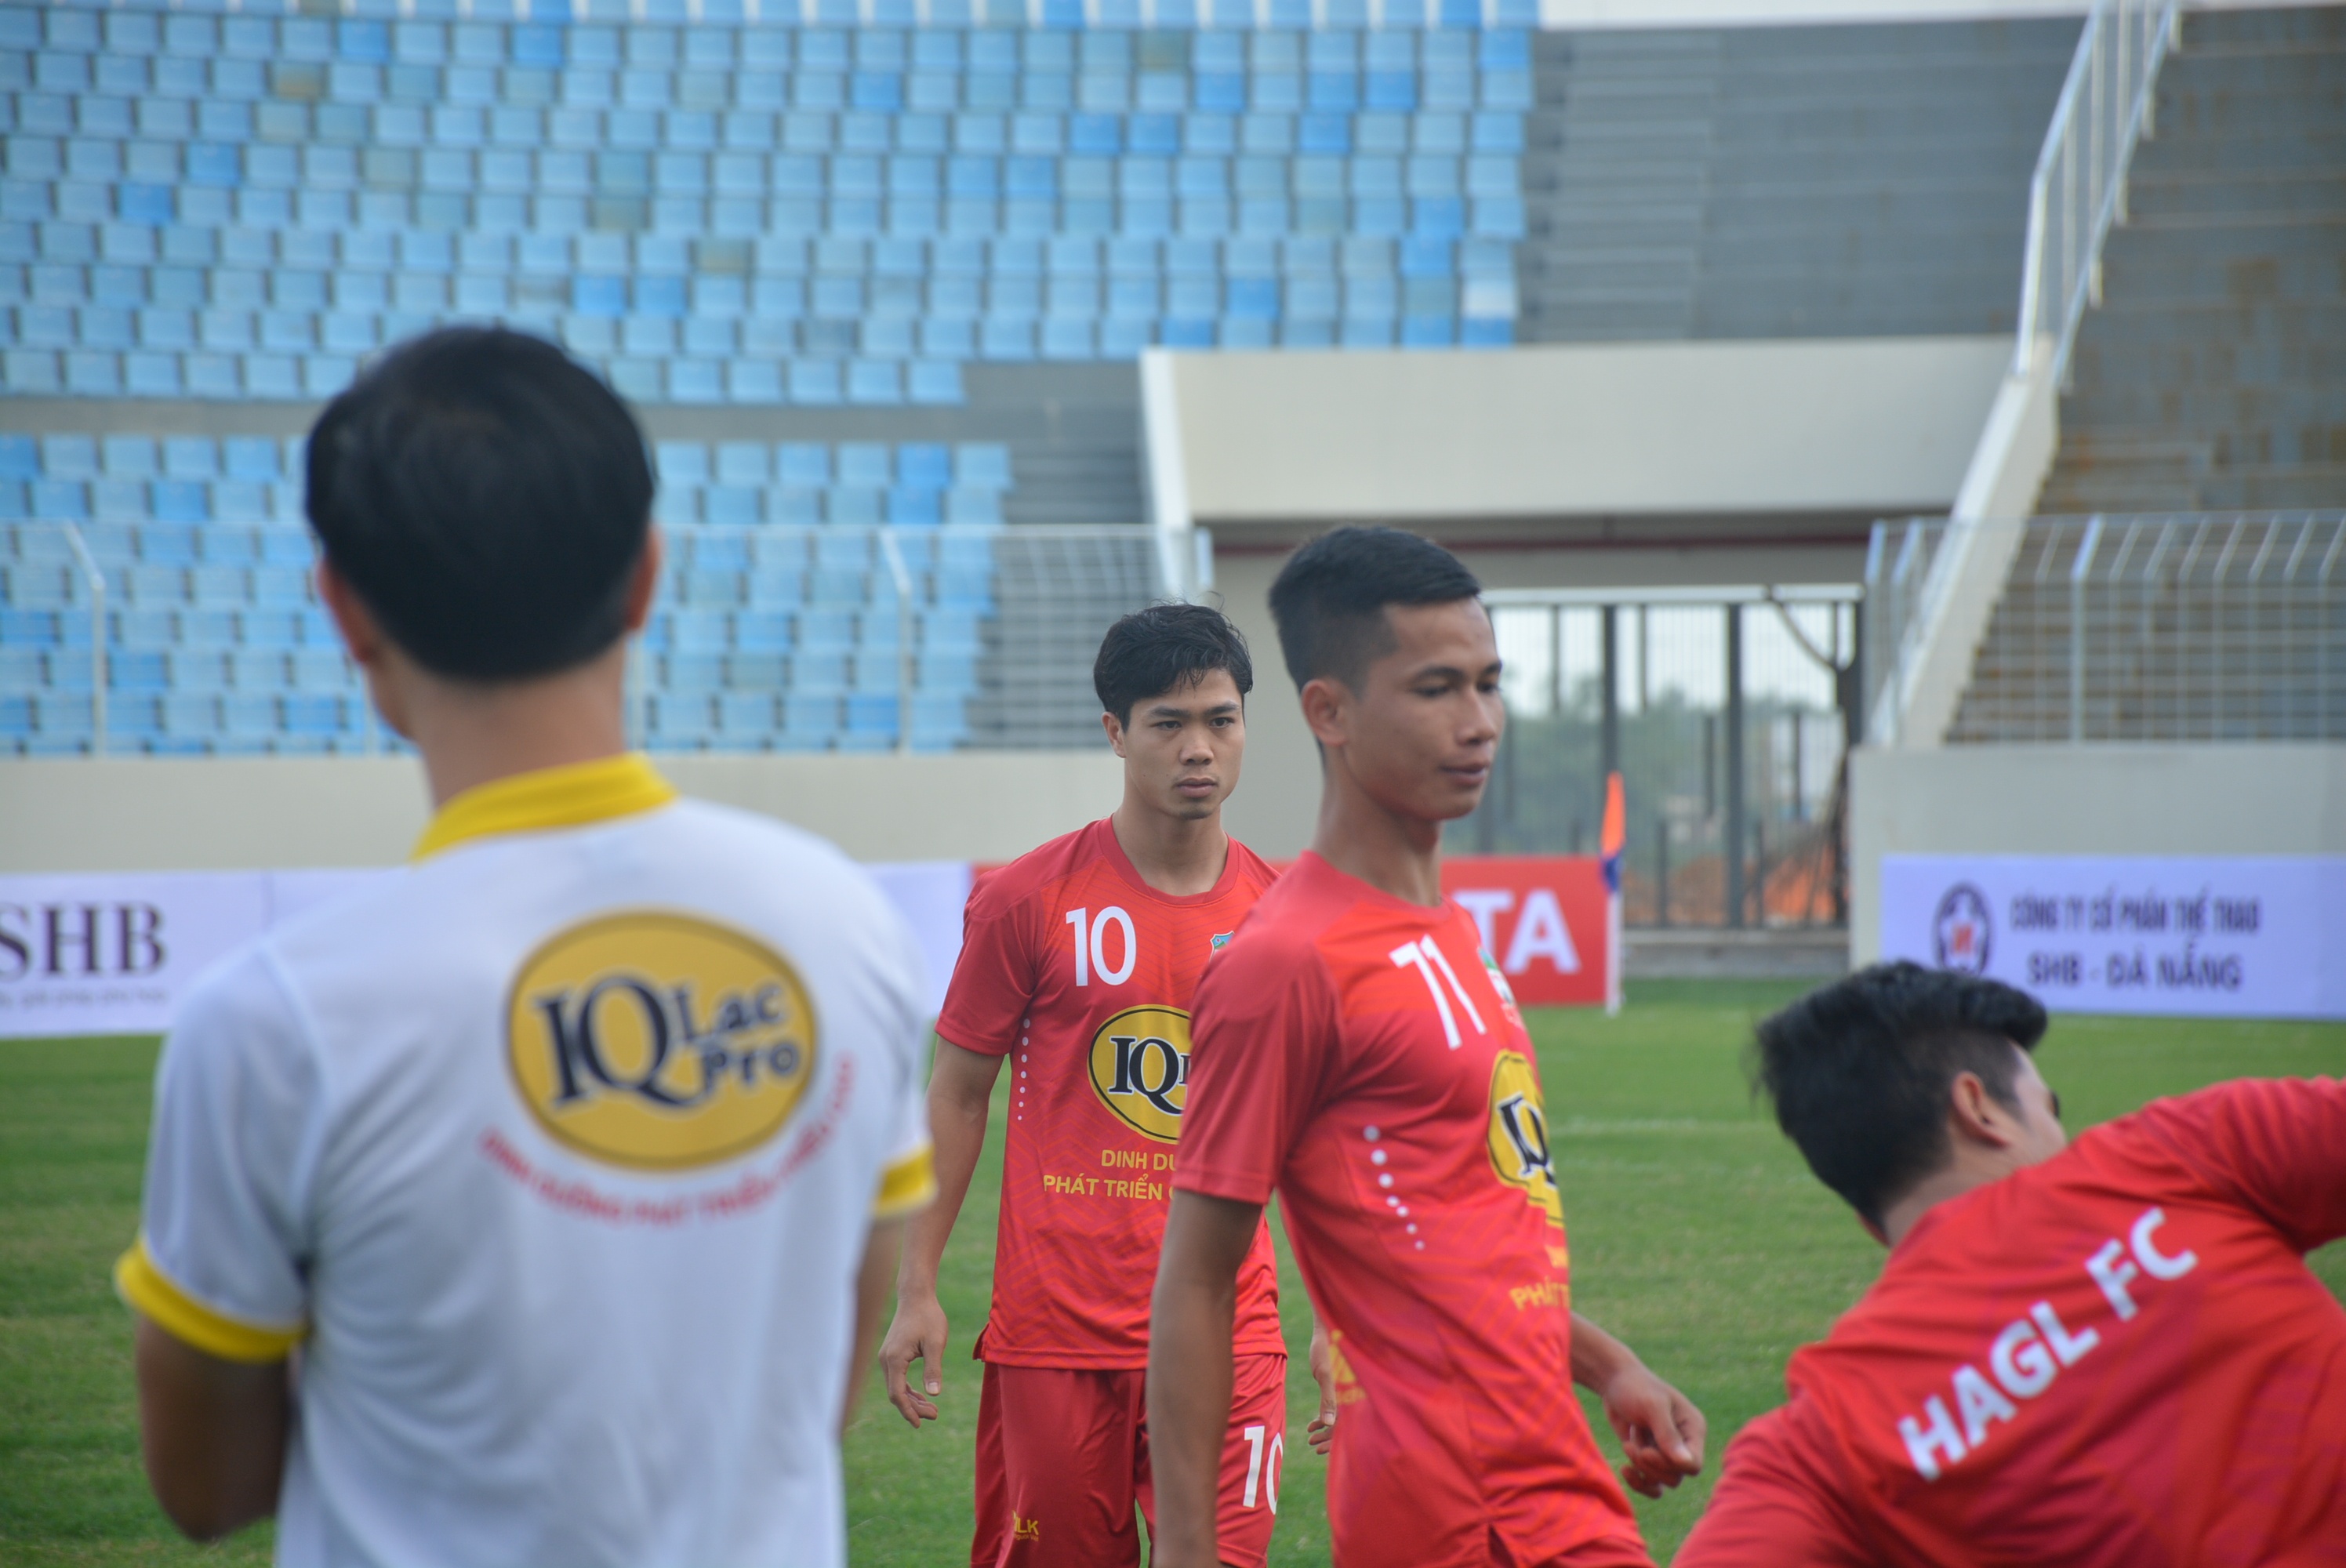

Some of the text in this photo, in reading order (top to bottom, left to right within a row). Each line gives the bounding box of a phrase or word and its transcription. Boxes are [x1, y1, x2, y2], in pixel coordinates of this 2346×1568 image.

[0, 902, 166, 978] SHB
[1066, 906, 1137, 986] 10
[1043, 1173, 1099, 1196] PHÁT
[1103, 1173, 1163, 1201] TRIỂN
[1101, 1149, 1147, 1170] DINH
[1897, 1207, 2199, 1482] HAGL FC
